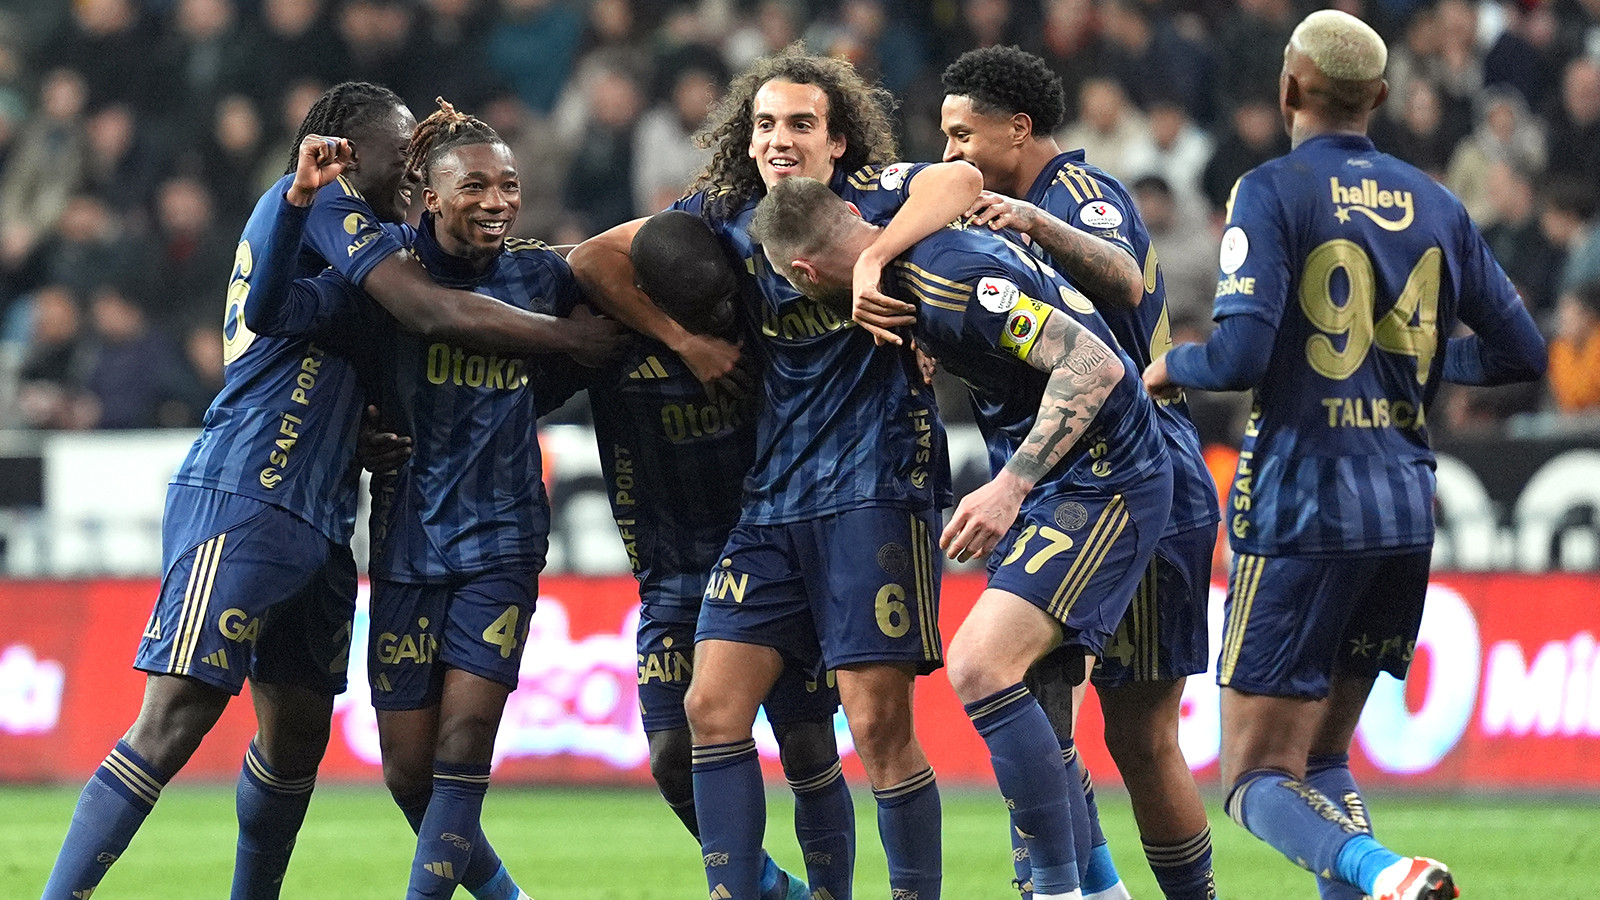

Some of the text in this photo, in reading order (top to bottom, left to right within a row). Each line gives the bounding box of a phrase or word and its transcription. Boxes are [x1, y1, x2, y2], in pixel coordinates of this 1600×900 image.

[1330, 177, 1415, 232] halley
[1300, 238, 1442, 385] 94
[291, 341, 325, 406] PORT
[1321, 397, 1427, 431] TALISCA
[613, 443, 636, 506] PORT
[483, 605, 532, 664] 4
[875, 583, 911, 638] 6
